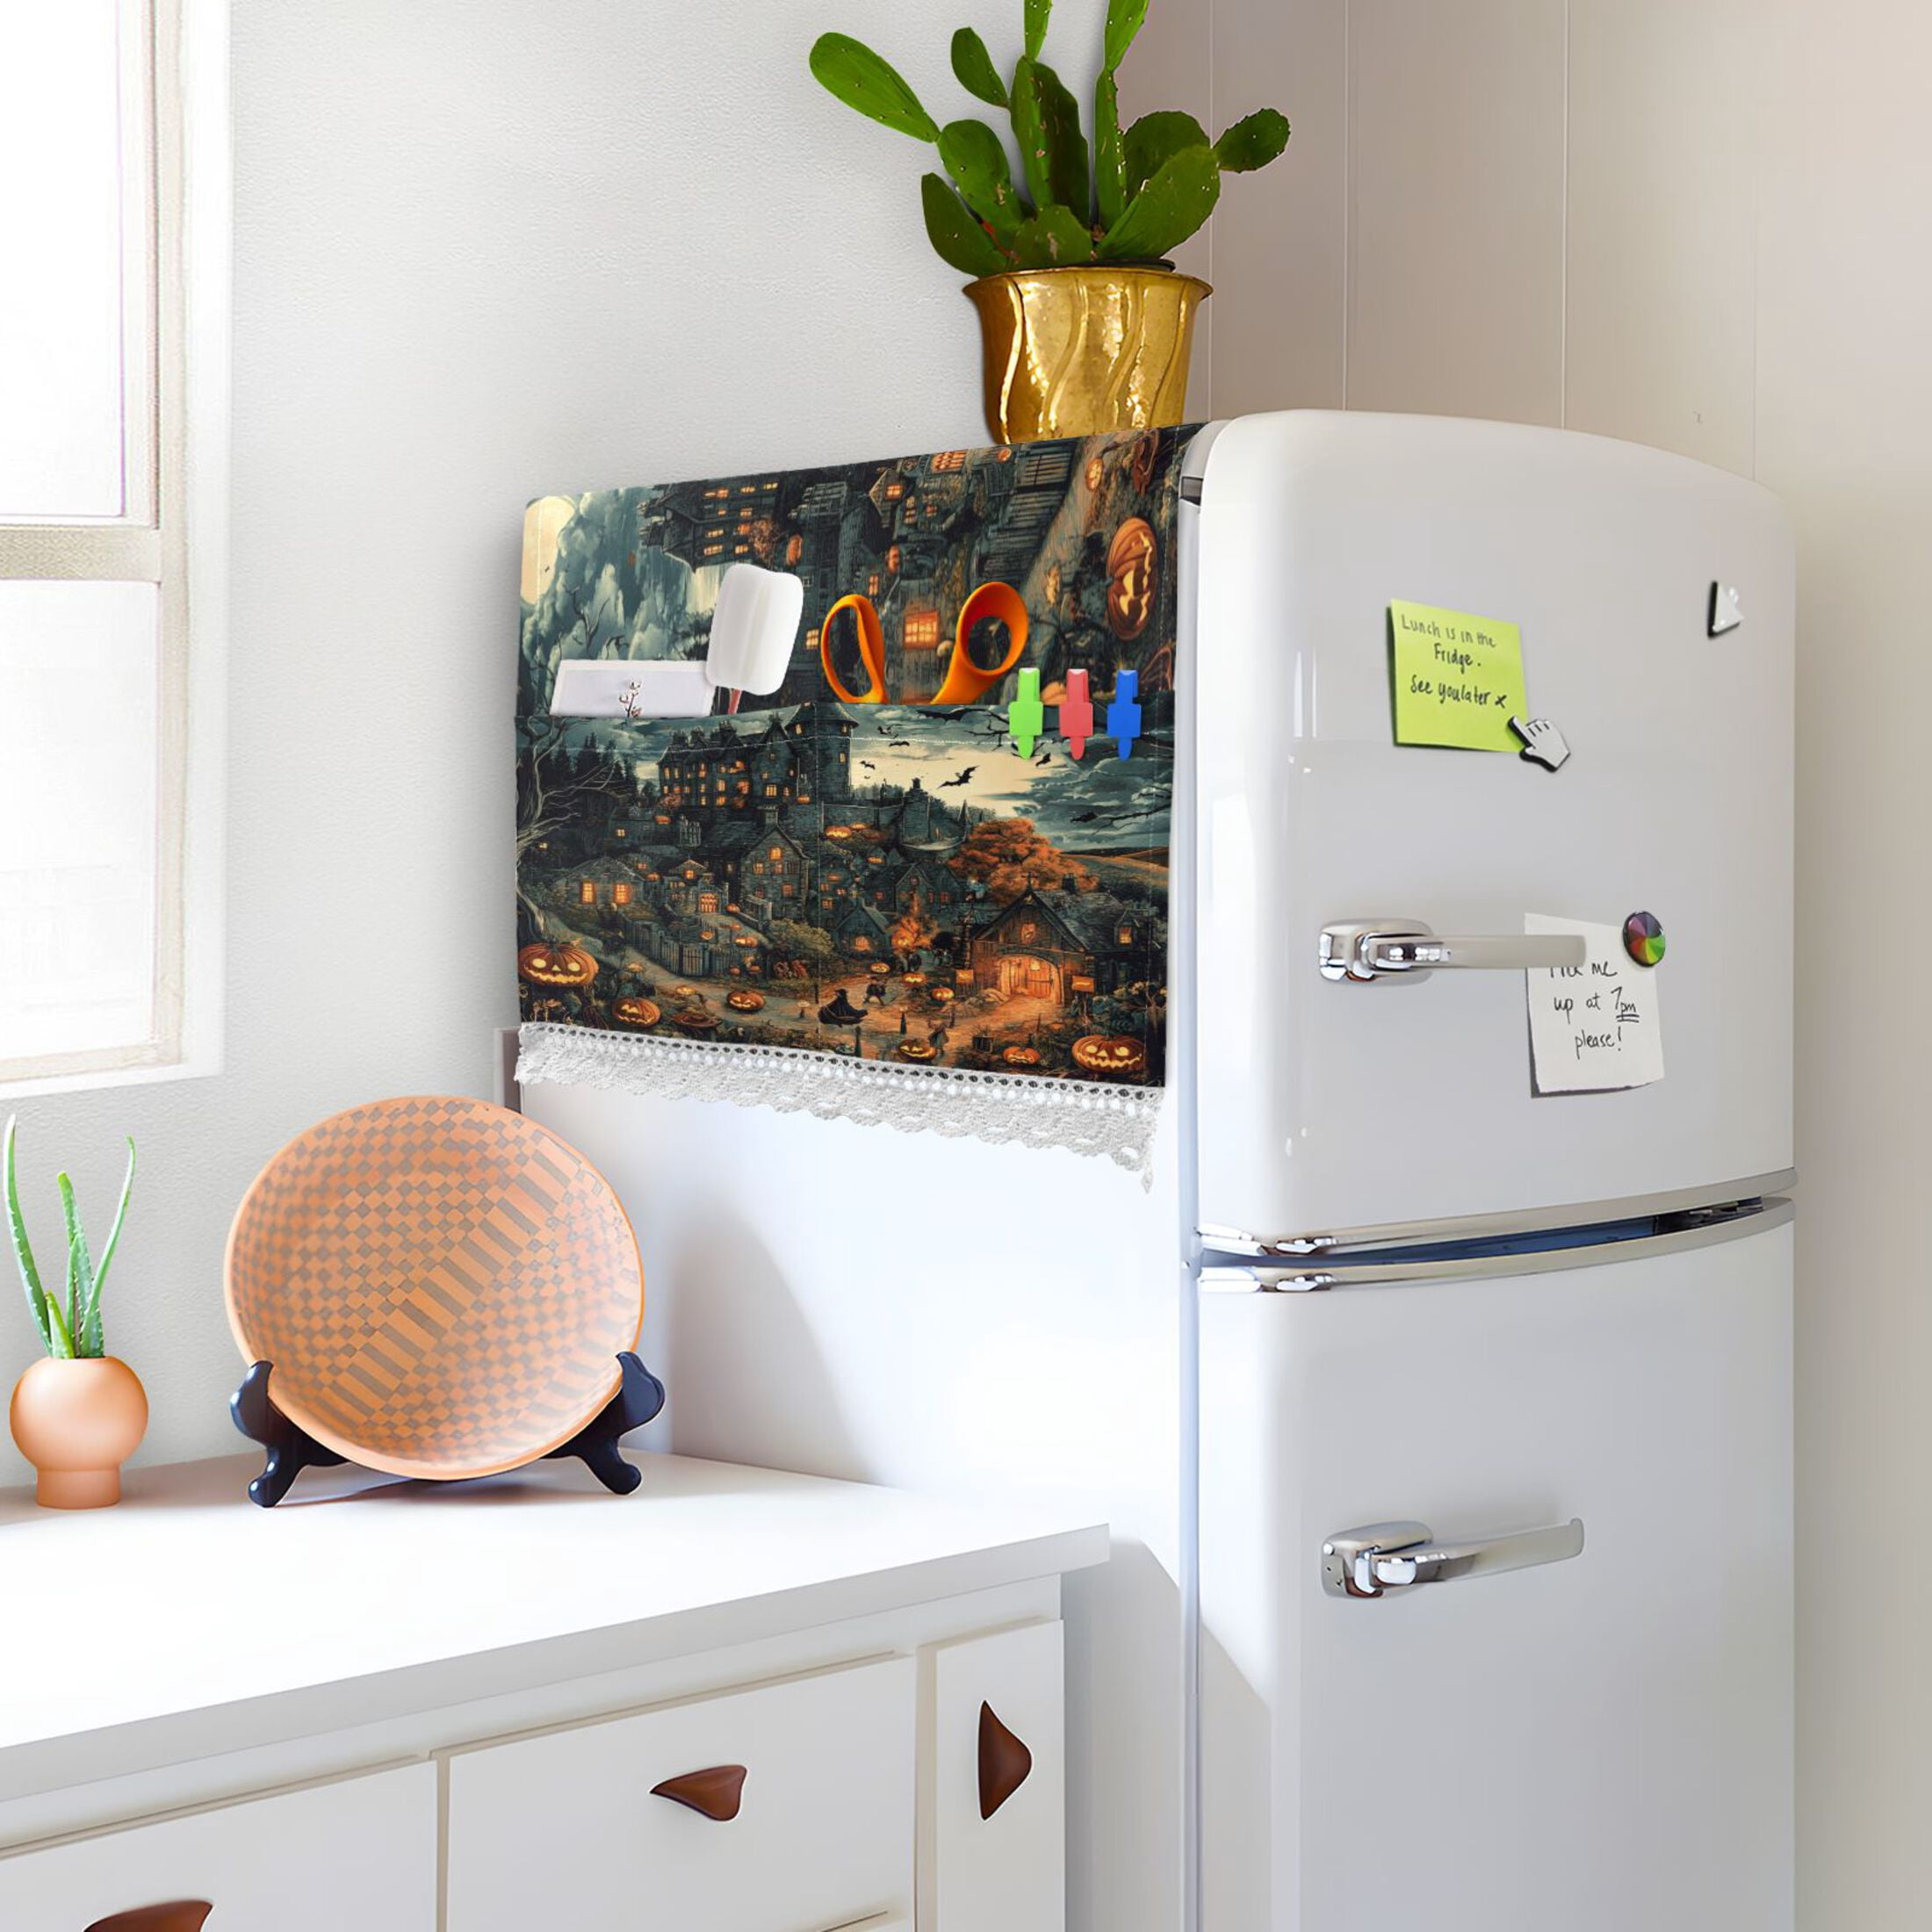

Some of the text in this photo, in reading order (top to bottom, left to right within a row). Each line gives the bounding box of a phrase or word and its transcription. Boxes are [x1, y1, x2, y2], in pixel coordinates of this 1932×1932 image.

[1401, 613, 1496, 648] Lunch is in the
[1410, 674, 1433, 695] See
[1591, 961, 1618, 977] me
[1554, 997, 1574, 1025] up
[1586, 991, 1601, 1011] at
[1575, 1025, 1622, 1060] please!
